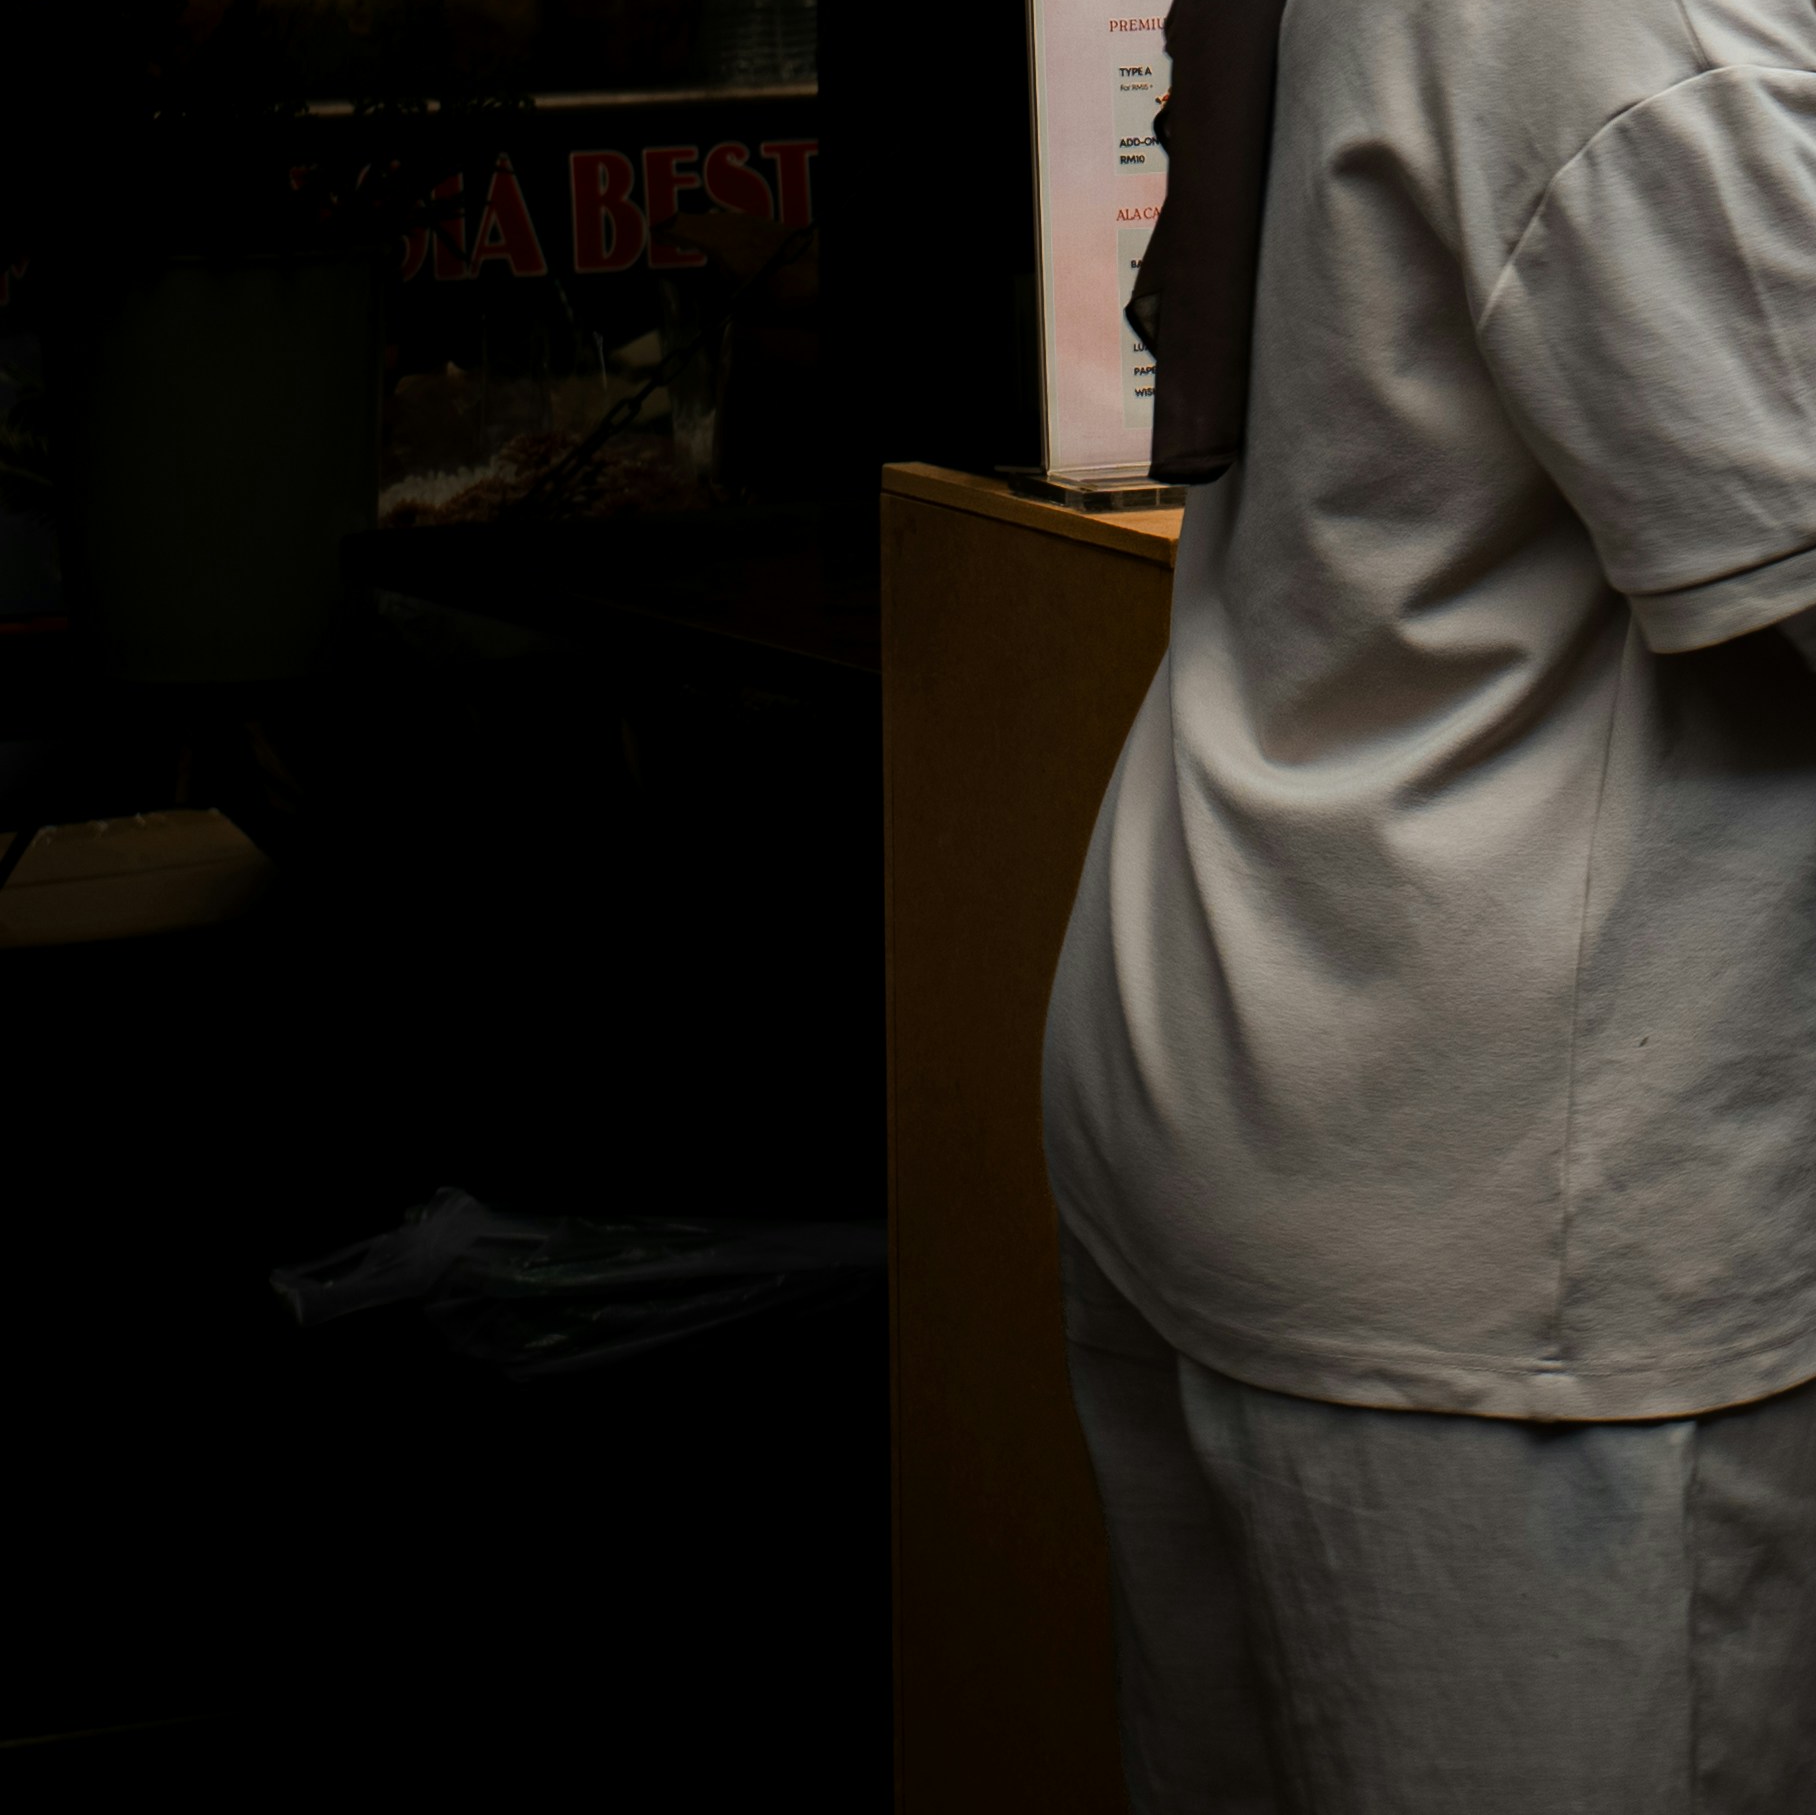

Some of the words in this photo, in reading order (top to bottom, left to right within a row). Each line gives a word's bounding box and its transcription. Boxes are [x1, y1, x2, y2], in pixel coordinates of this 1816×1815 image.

[1119, 67, 1143, 77] TYPE
[1144, 66, 1152, 76] A
[1120, 154, 1146, 165] RM10
[569, 138, 819, 275] BEST
[1116, 209, 1141, 221] ALA
